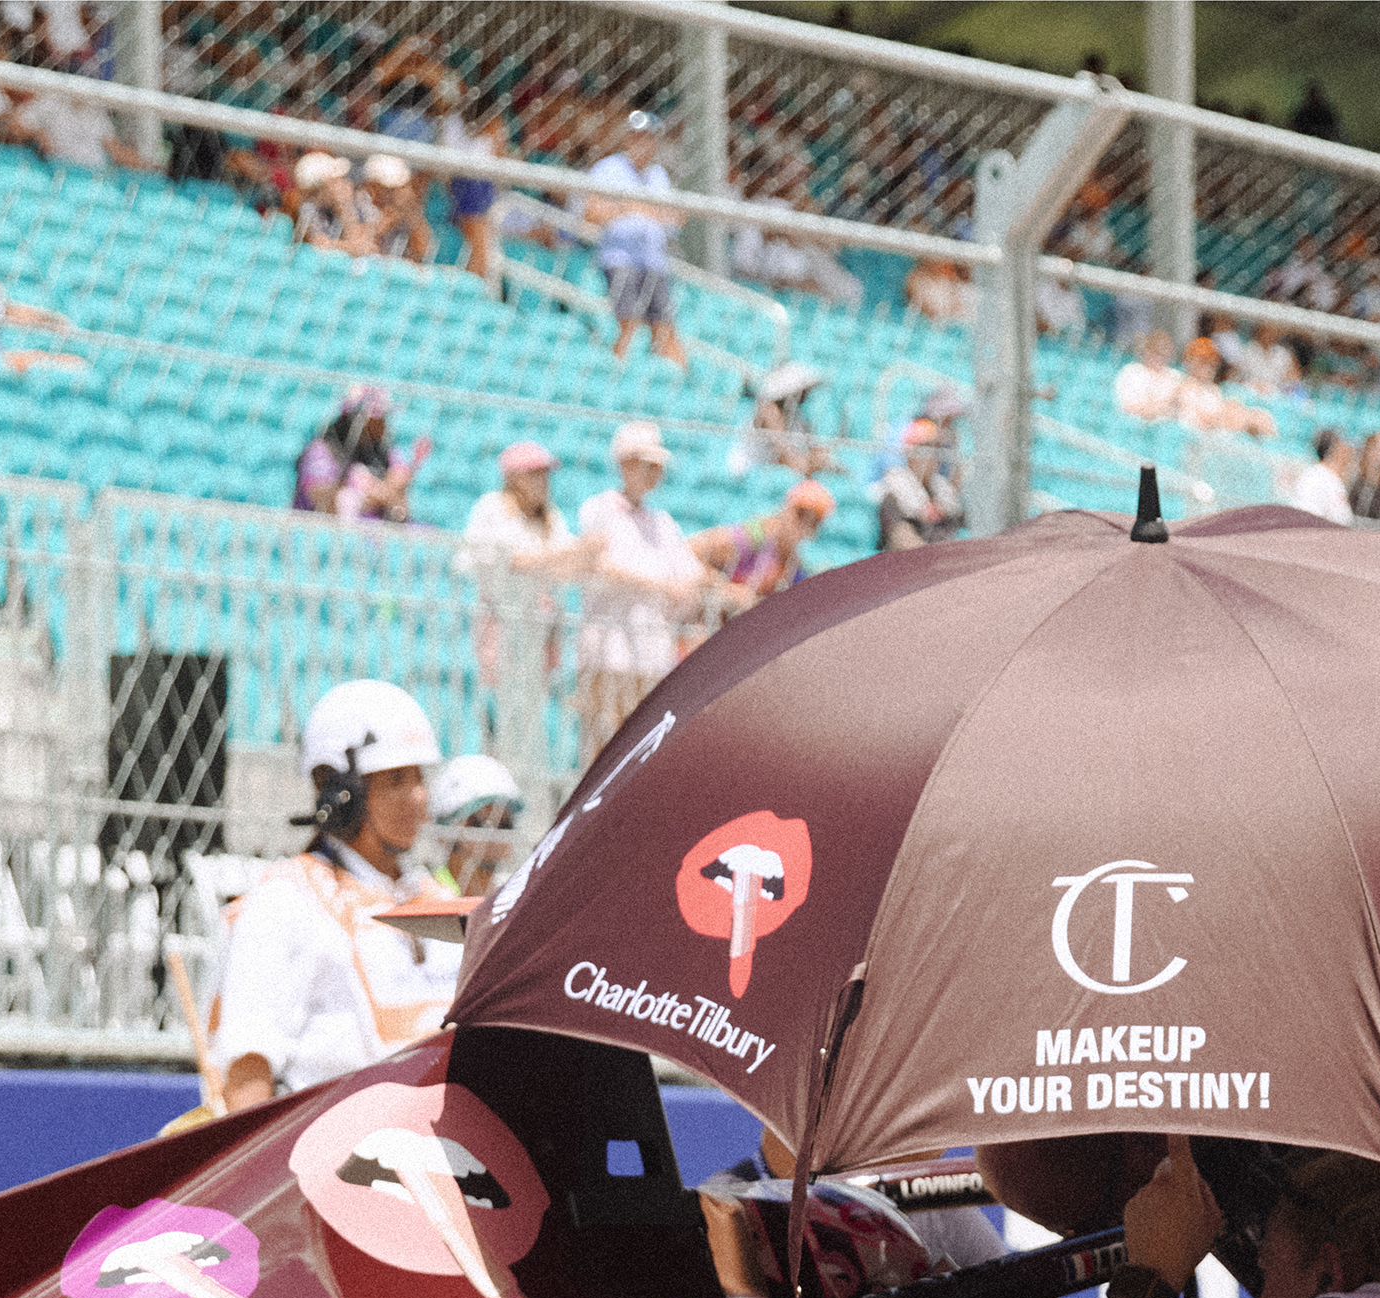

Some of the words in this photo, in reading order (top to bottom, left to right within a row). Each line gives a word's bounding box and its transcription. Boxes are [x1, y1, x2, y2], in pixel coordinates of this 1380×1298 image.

[1035, 1025, 1207, 1067] MAKEUP
[966, 1075, 1073, 1115] YOUR
[1086, 1070, 1270, 1111] DESTINY!
